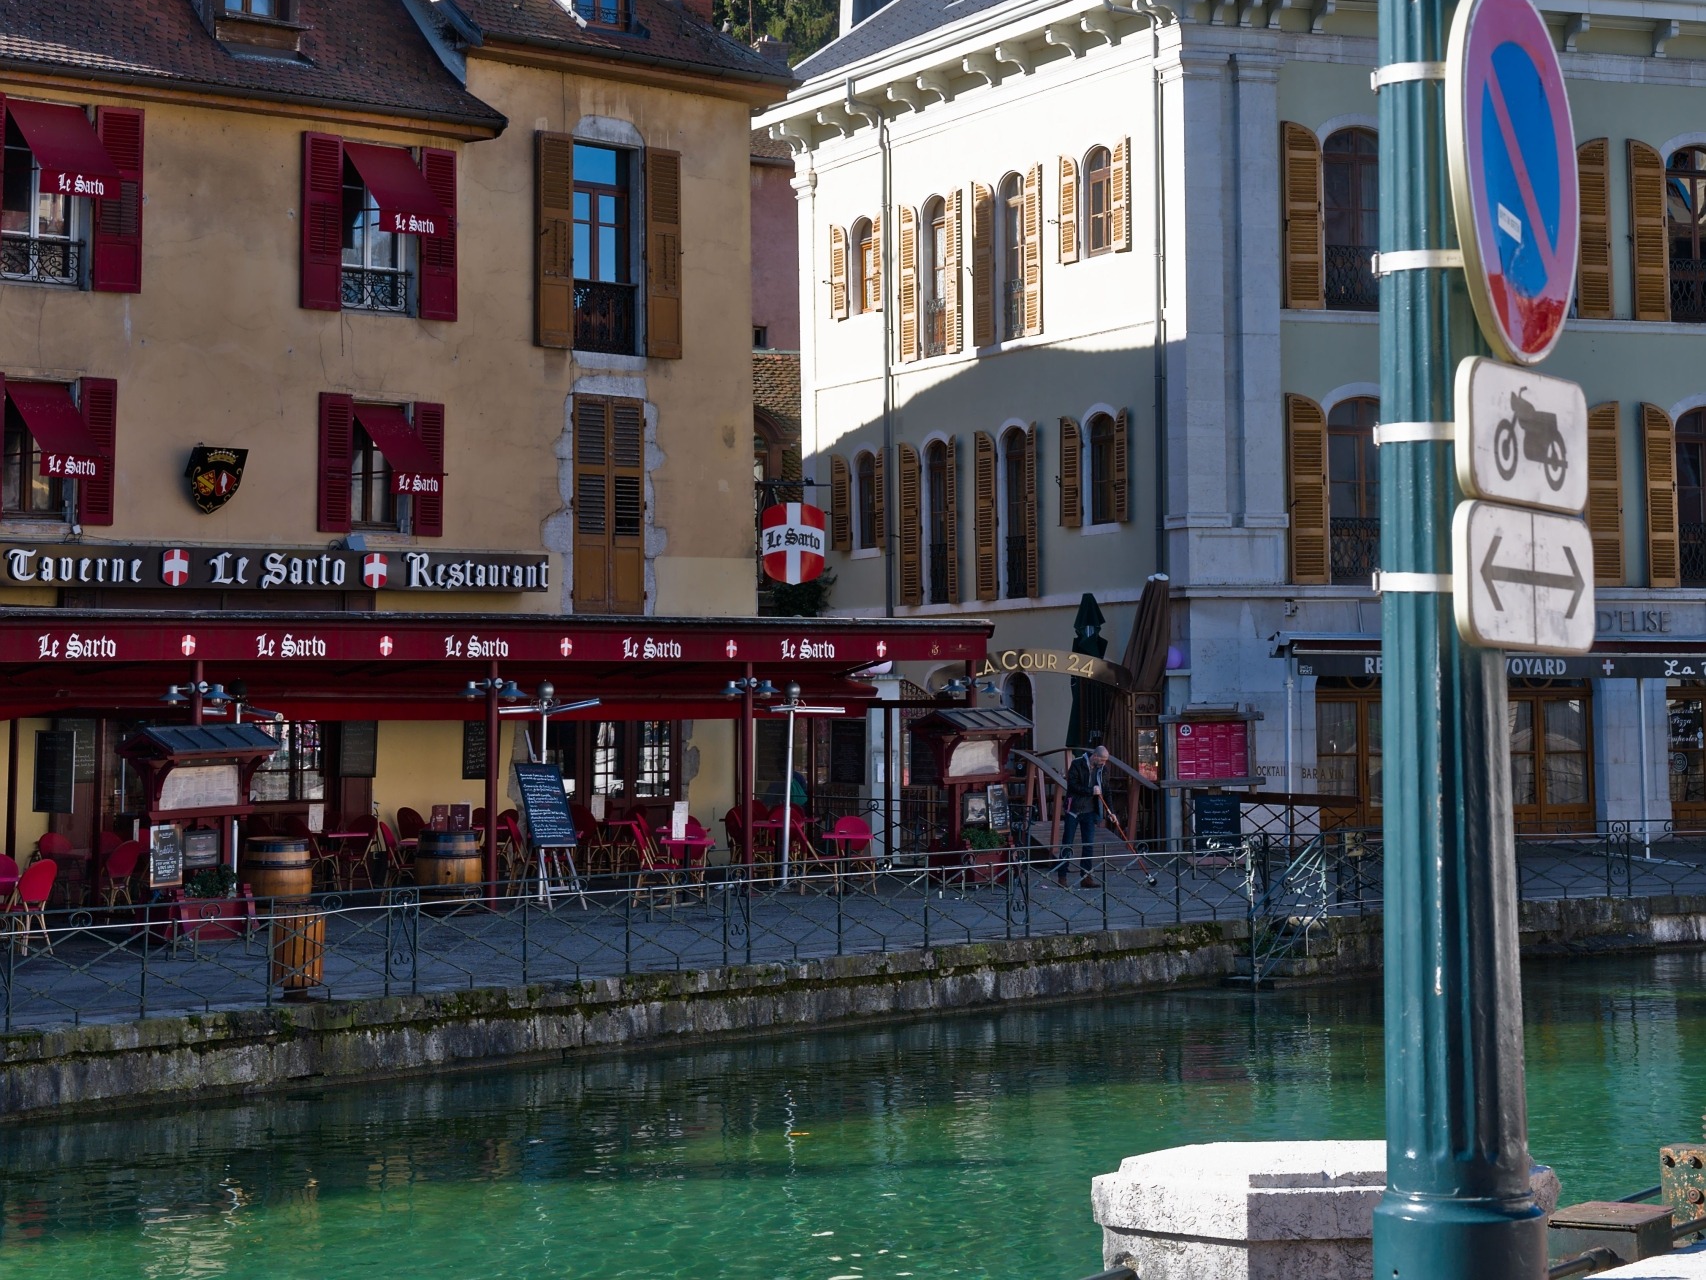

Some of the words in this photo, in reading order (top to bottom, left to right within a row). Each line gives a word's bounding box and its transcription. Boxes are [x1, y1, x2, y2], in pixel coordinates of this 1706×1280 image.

[58, 173, 72, 192] Le
[74, 175, 104, 196] Sarto
[394, 214, 407, 232] Le
[408, 215, 435, 234] Sarto
[48, 454, 62, 473] Le
[64, 456, 96, 476] Sarto
[398, 474, 410, 491] Le
[410, 475, 439, 493] Sarto
[766, 530, 782, 550] Le
[785, 527, 820, 550] Sarto
[8, 548, 143, 583] Taverne
[209, 551, 249, 585] Le
[261, 552, 346, 589] Sarto
[406, 552, 549, 590] Restaurant
[1596, 610, 1671, 633] D'ELISE
[38, 634, 59, 659] Le
[65, 633, 116, 659] Sarto
[256, 633, 275, 658] Le
[281, 633, 326, 658] Sarto
[445, 634, 462, 658] Le
[467, 635, 509, 658] Sarto
[623, 637, 639, 659] Le
[643, 637, 682, 659] Sarto
[781, 638, 796, 660] Le
[799, 639, 835, 659] Sarto
[1001, 650, 1058, 670] COUR
[1066, 654, 1095, 678] 24
[1664, 659, 1696, 677] La
[1671, 715, 1692, 728] Pizza
[1256, 765, 1288, 777] OCKTAIL
[1301, 768, 1318, 779] BAR
[1329, 769, 1344, 780] VIN
